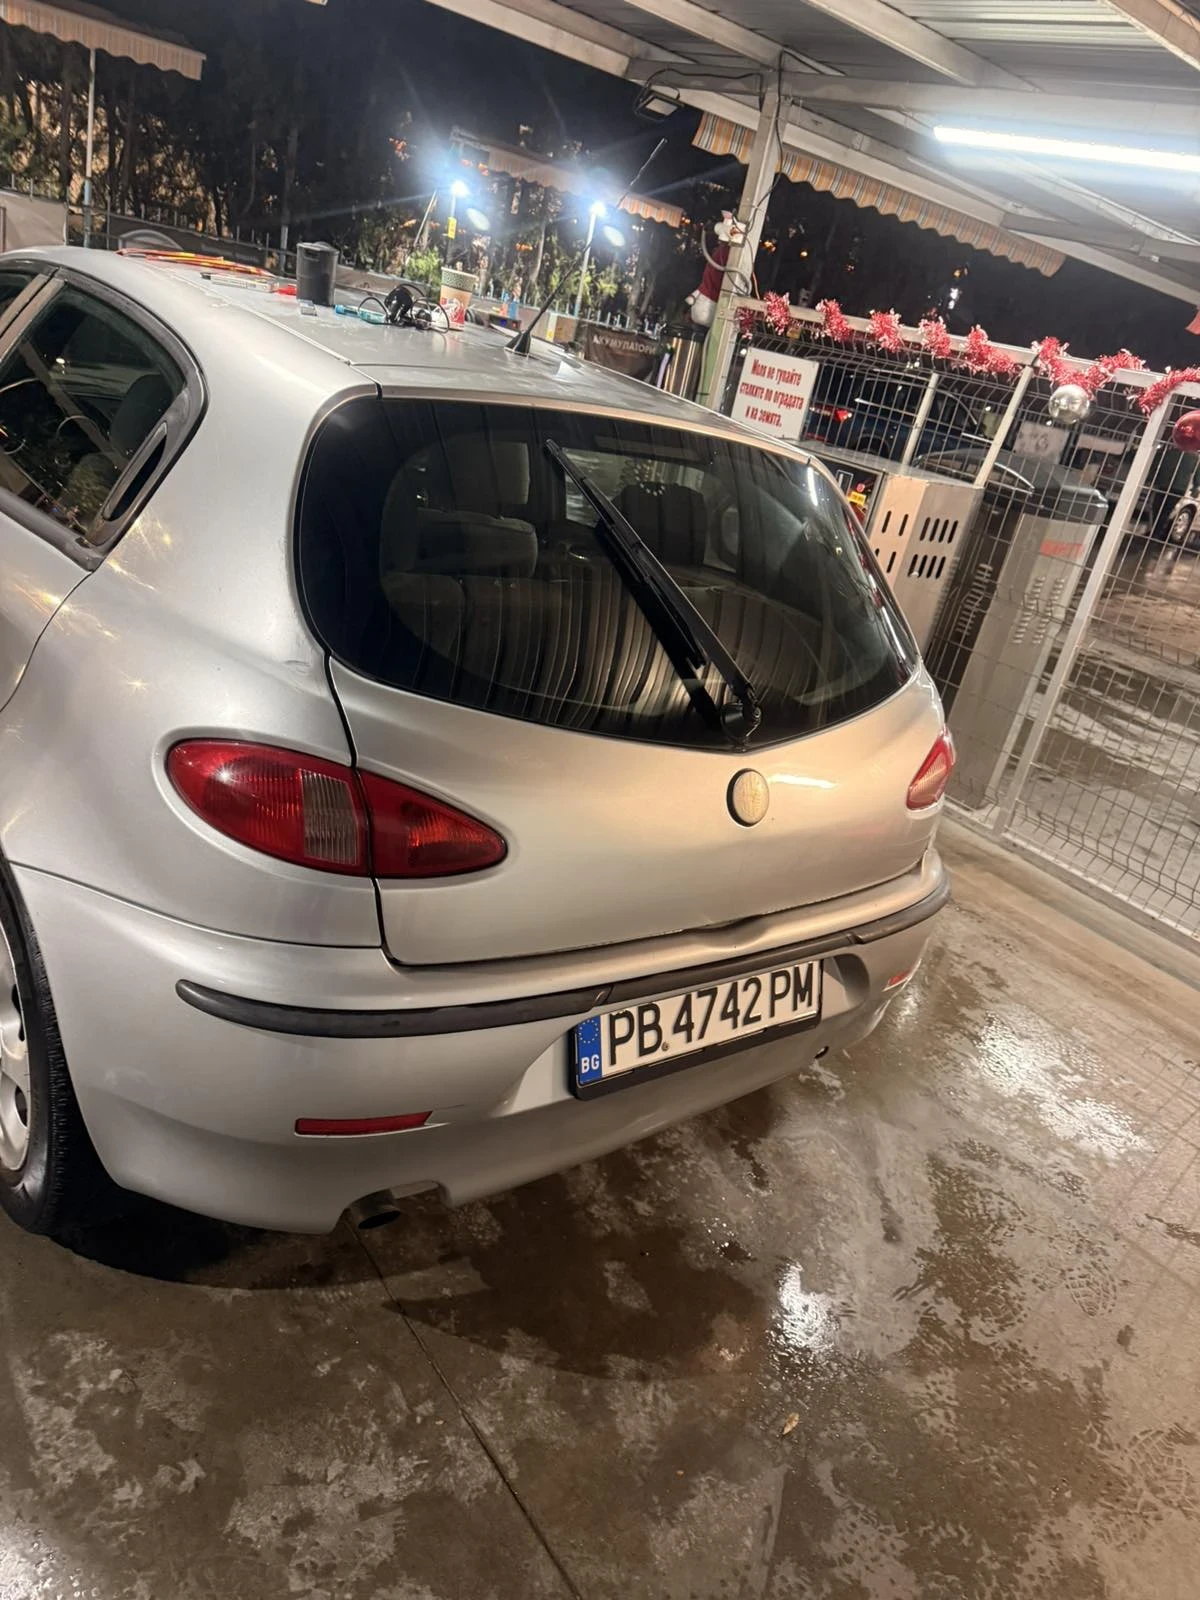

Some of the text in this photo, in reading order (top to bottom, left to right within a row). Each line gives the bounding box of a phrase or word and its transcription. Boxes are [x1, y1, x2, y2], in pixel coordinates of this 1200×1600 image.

[751, 359, 767, 378] Моля
[766, 366, 775, 379] не
[764, 388, 773, 403] по
[773, 390, 804, 411] оградата
[750, 407, 759, 420] на
[609, 962, 814, 1066] PB 4742 PM
[581, 1054, 600, 1074] BG
